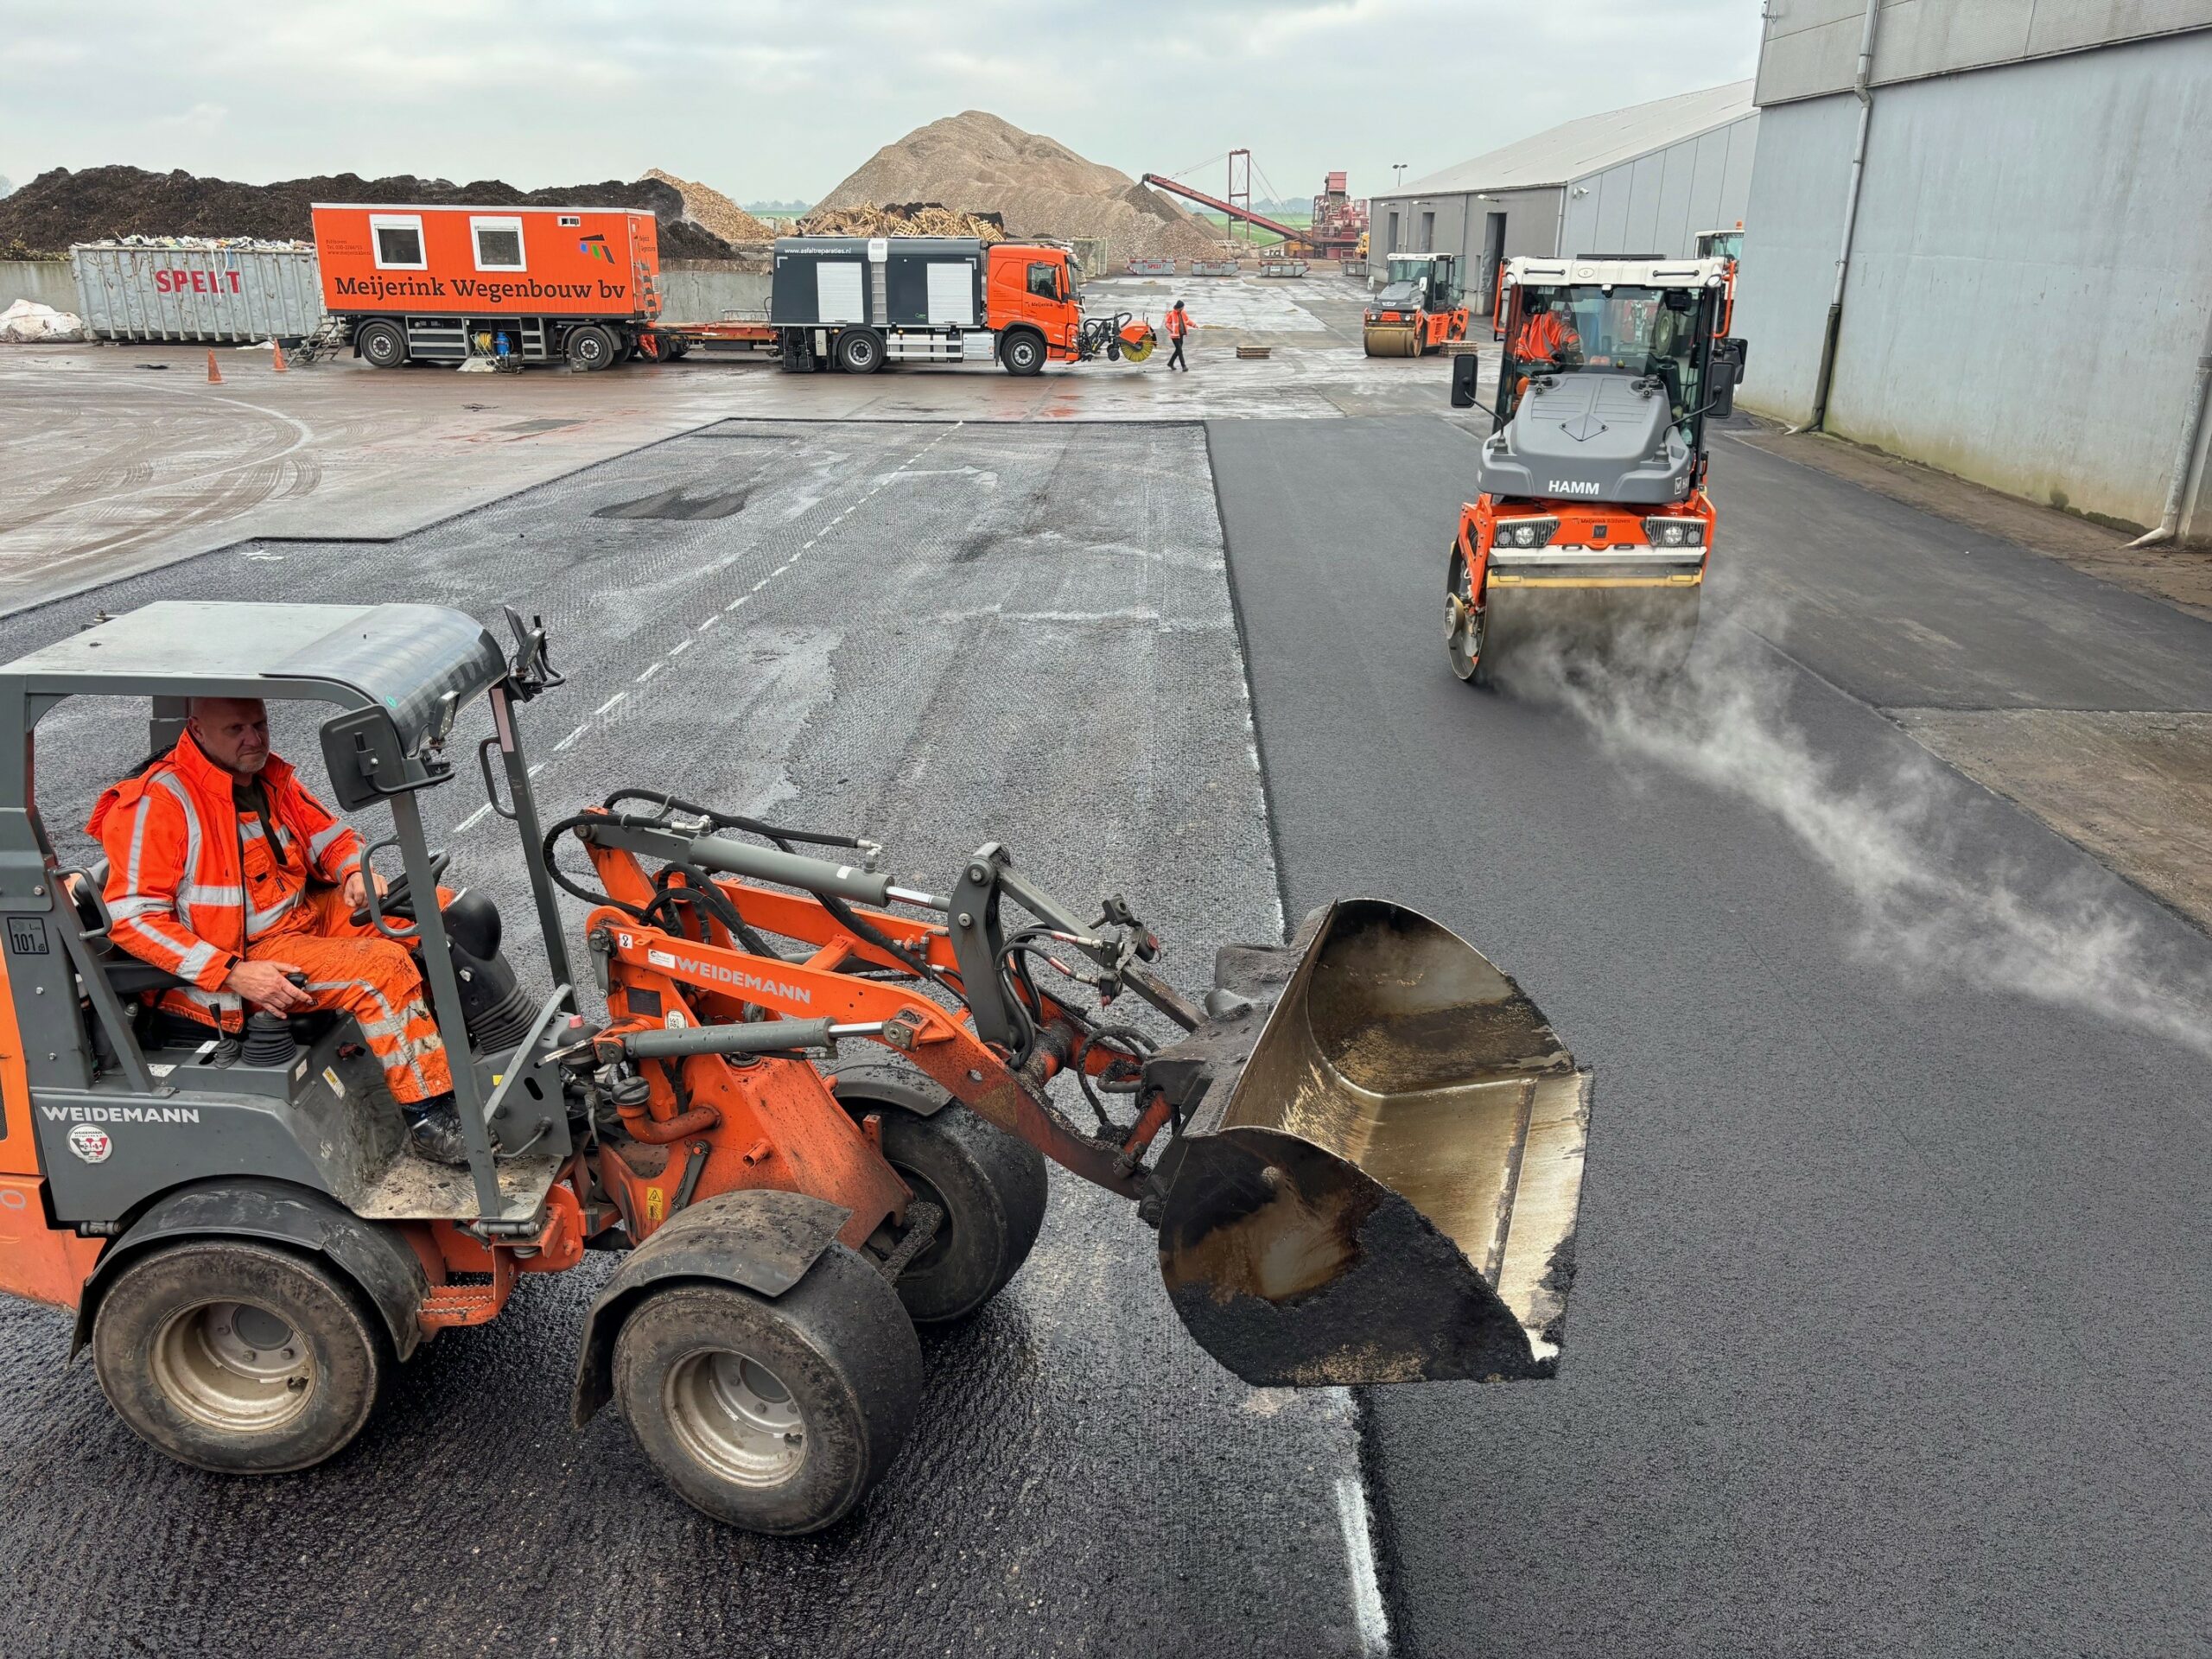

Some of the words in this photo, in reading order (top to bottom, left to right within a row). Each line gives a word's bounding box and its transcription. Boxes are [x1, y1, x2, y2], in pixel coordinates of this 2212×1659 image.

[156, 270, 240, 294] SPELT
[334, 276, 446, 301] Meijerink
[450, 278, 592, 302] Wegenbouw
[598, 280, 626, 298] bv
[1548, 480, 1600, 495] HAMM
[14, 933, 36, 951] 101
[675, 955, 811, 1004] WEIDEMANN
[41, 1106, 200, 1123] WEIDEMANN
